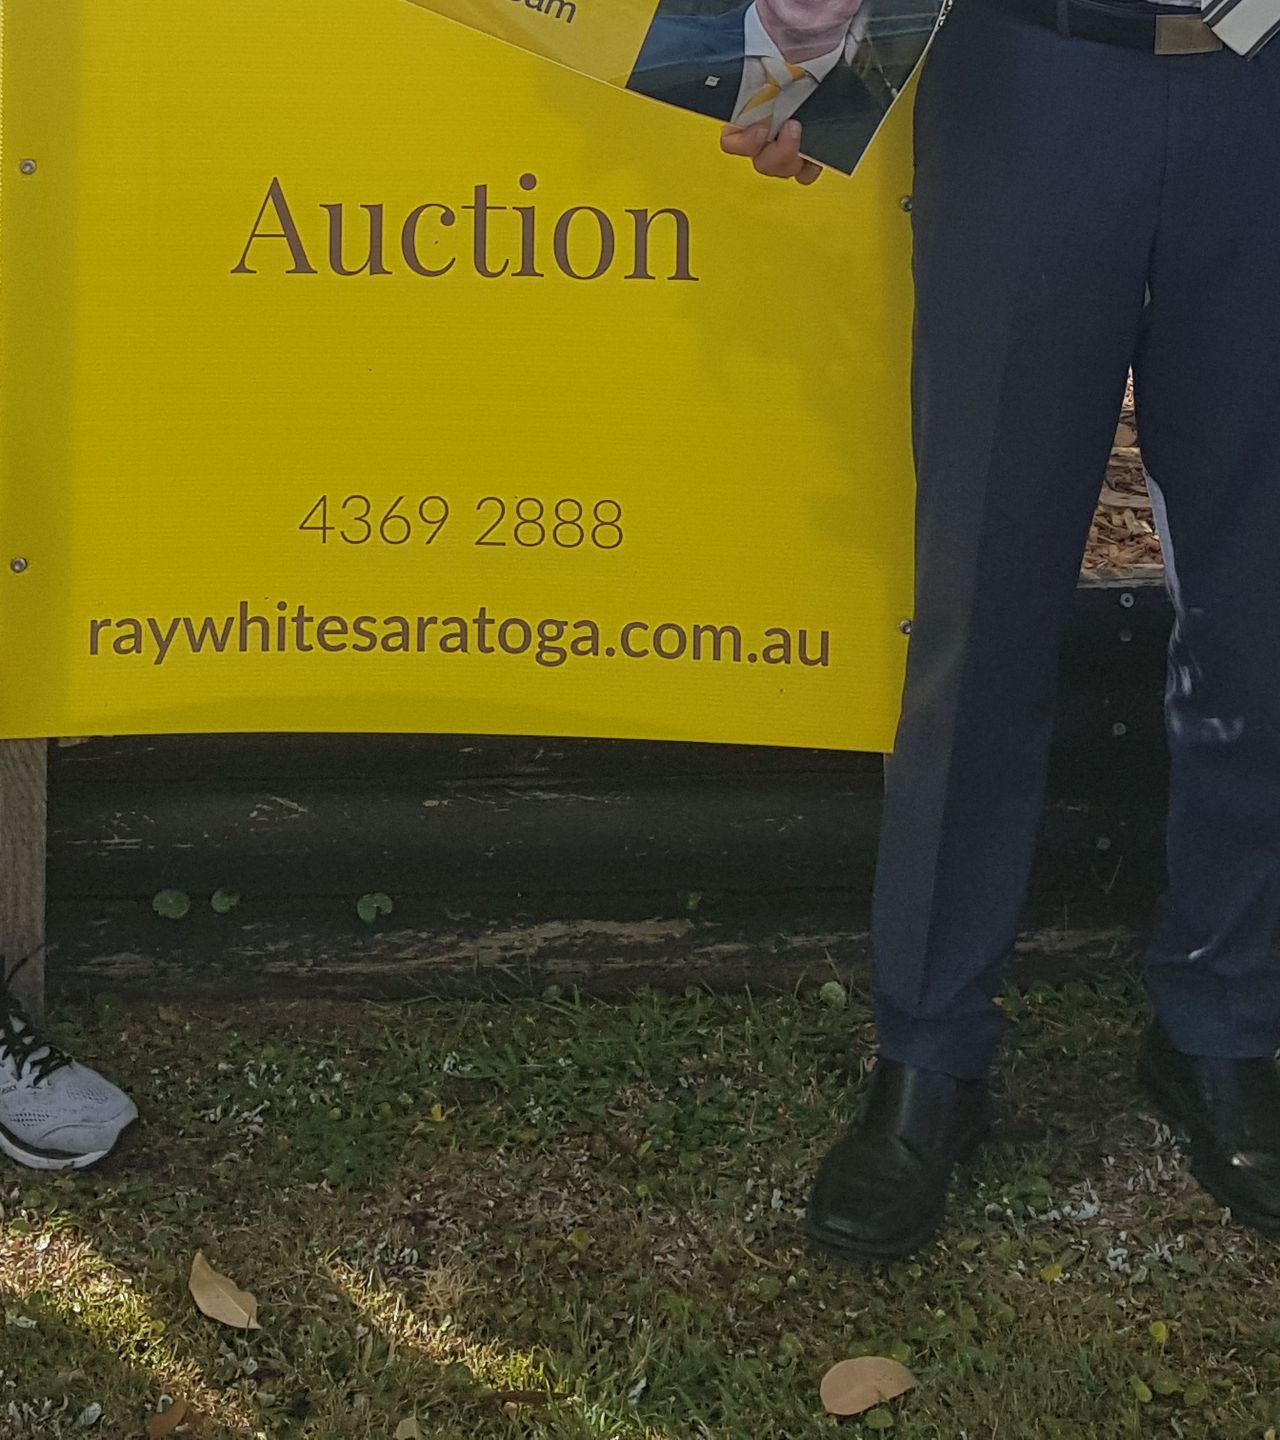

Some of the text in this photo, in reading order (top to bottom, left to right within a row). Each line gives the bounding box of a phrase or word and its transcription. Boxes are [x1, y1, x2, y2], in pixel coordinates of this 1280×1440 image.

[230, 173, 700, 282] Auction
[298, 494, 624, 550] 4369 2888
[89, 600, 830, 668] raywhitesaratoga.com.au
